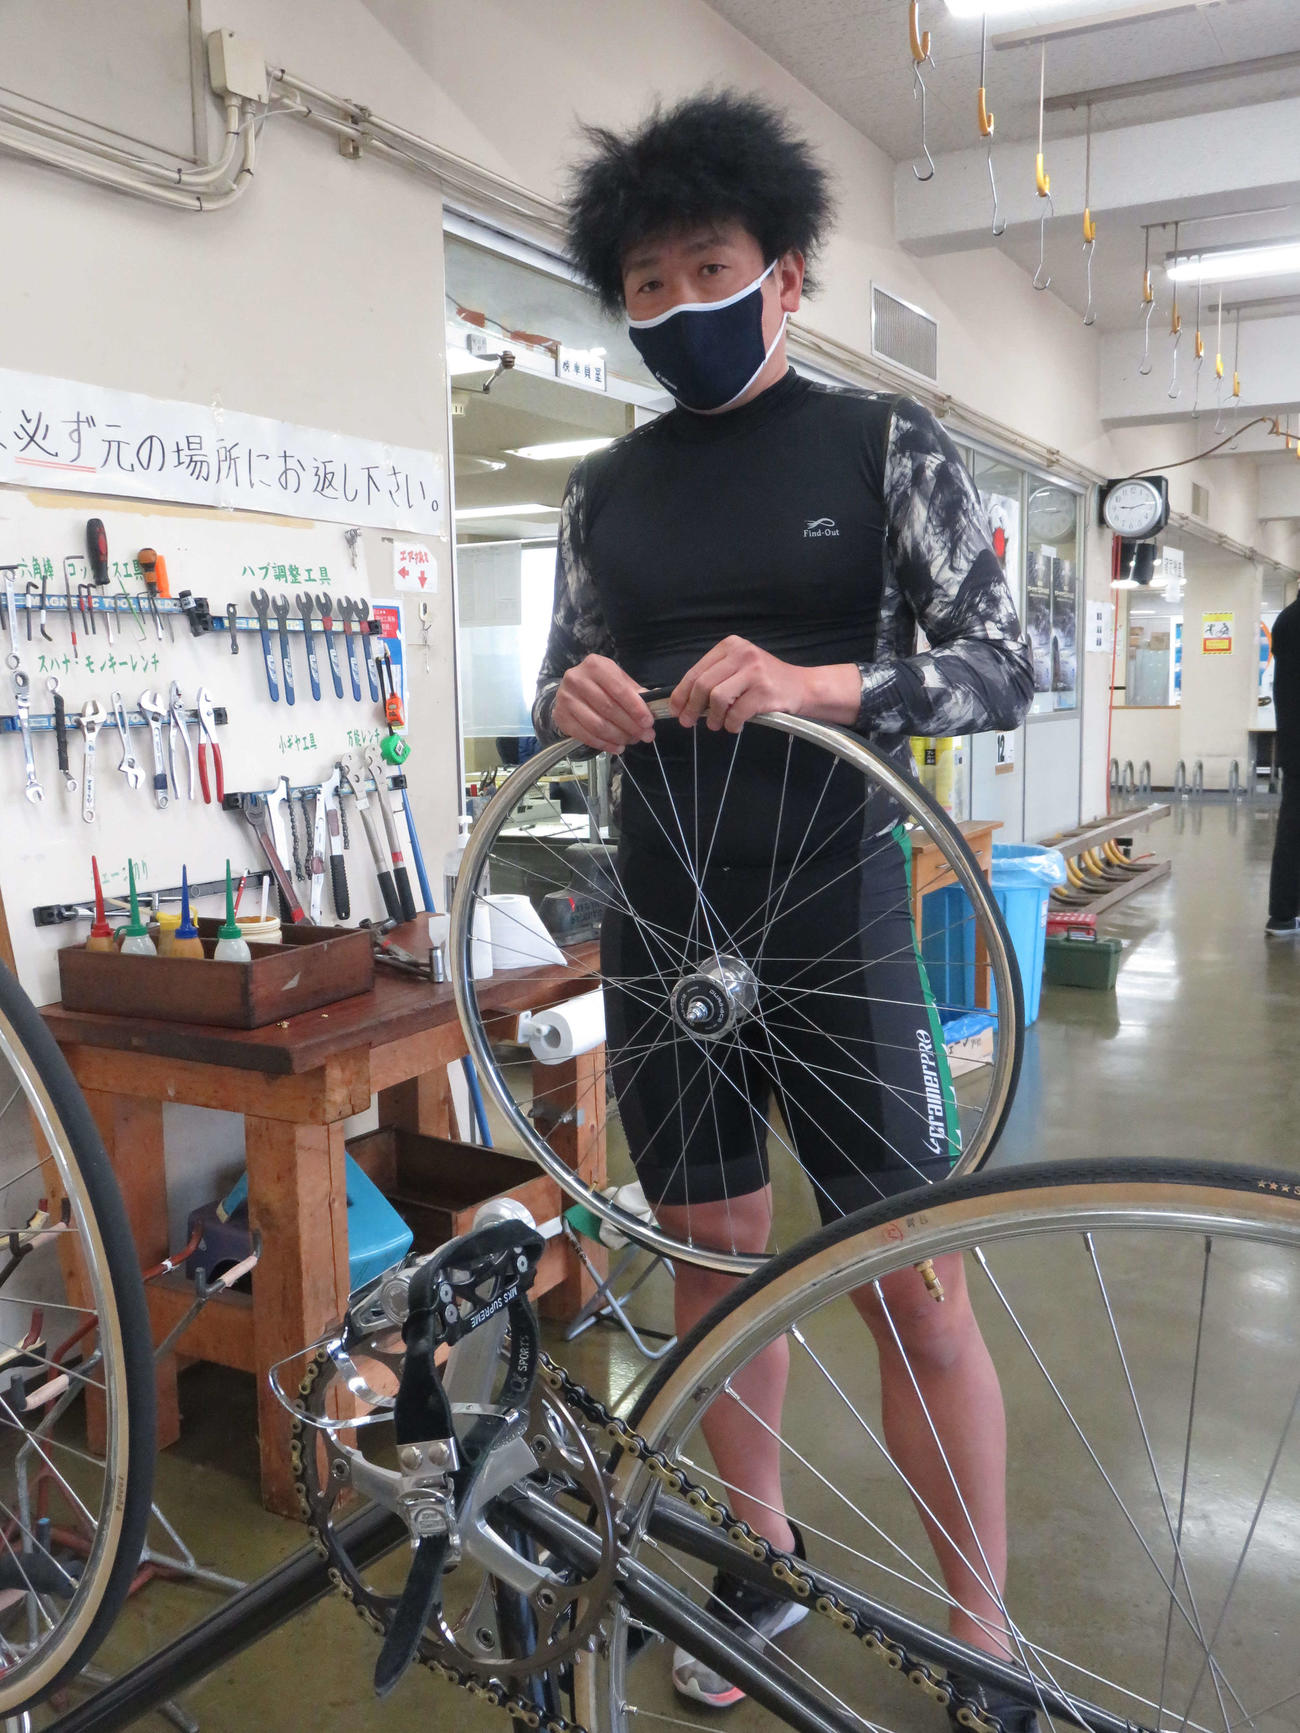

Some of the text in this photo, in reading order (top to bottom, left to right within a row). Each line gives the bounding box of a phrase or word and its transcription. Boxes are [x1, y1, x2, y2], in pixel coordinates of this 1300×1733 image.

[803, 528, 840, 538] Find-Out
[241, 561, 332, 586] ハブ調整工具
[470, 1286, 519, 1328] MKS SUPREME
